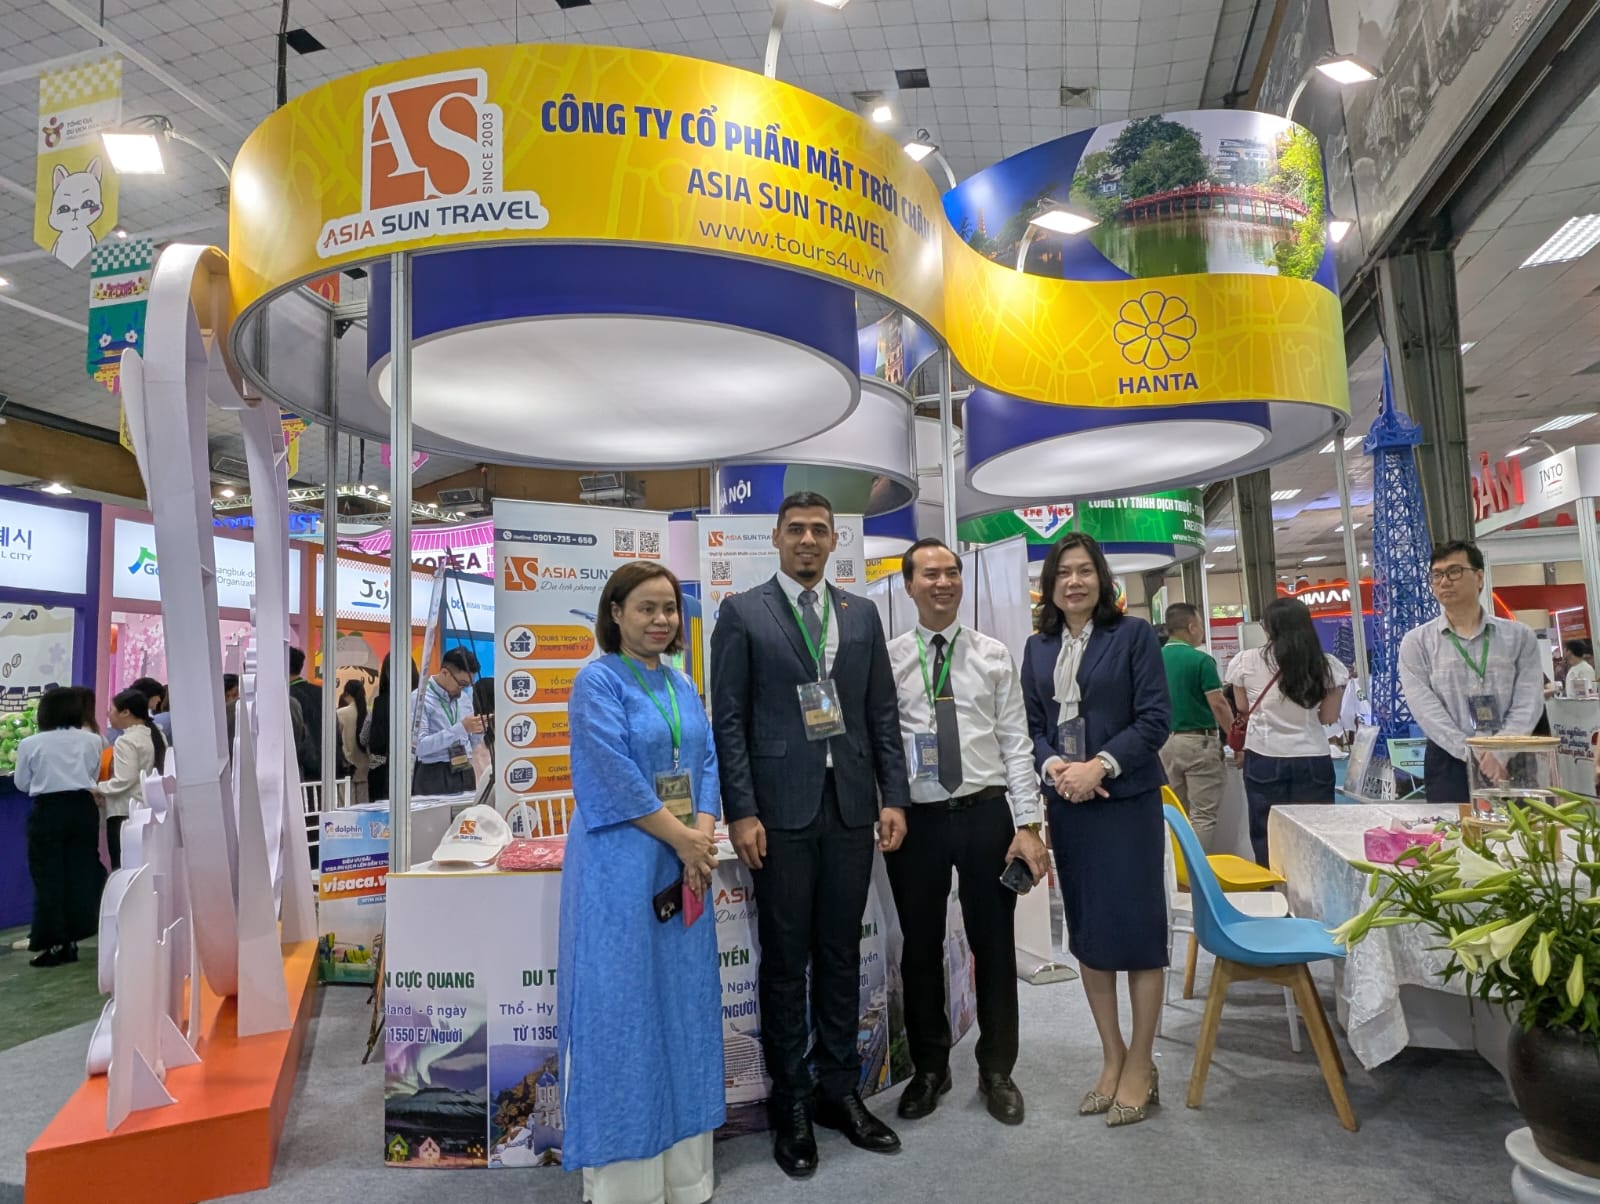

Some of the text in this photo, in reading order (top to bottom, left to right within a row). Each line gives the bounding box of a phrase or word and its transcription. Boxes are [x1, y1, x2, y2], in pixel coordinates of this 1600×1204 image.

[370, 92, 479, 201] AS
[482, 112, 493, 194] SINCE 2003
[541, 93, 626, 135] CÔNG
[634, 106, 673, 139] TY
[680, 105, 718, 147] CỔ
[725, 122, 800, 169] PHẦN
[806, 145, 854, 191] MẶT
[858, 168, 899, 217] TRỜI
[687, 168, 889, 254] ASIA SUN TRAVEL
[323, 200, 539, 249] ASIA SUN TRAVEL
[699, 220, 885, 286] www.tours4u.vn
[1118, 372, 1199, 395] HANTA
[1538, 463, 1563, 494] JNTO
[728, 479, 751, 504] NỘI
[1117, 497, 1129, 509] TY
[1130, 496, 1156, 509] TNHH
[533, 534, 552, 542] 0901
[742, 533, 757, 541] SUN
[9, 552, 32, 561] CITY
[504, 557, 539, 592] AS
[541, 567, 577, 580] ASIA
[580, 568, 608, 580] SUN
[334, 824, 363, 834] dolphin
[715, 909, 738, 924] Du
[395, 970, 422, 992] CỰC
[427, 972, 475, 990] QUANG
[522, 970, 543, 987] DU
[728, 980, 757, 994] Ngày
[426, 1005, 433, 1016] 6
[437, 1004, 467, 1019] ngày
[500, 1001, 524, 1016] Thổ
[536, 1003, 554, 1017] Hy
[390, 1028, 463, 1045] 1550 E/ Người
[513, 1025, 528, 1042] TỪ
